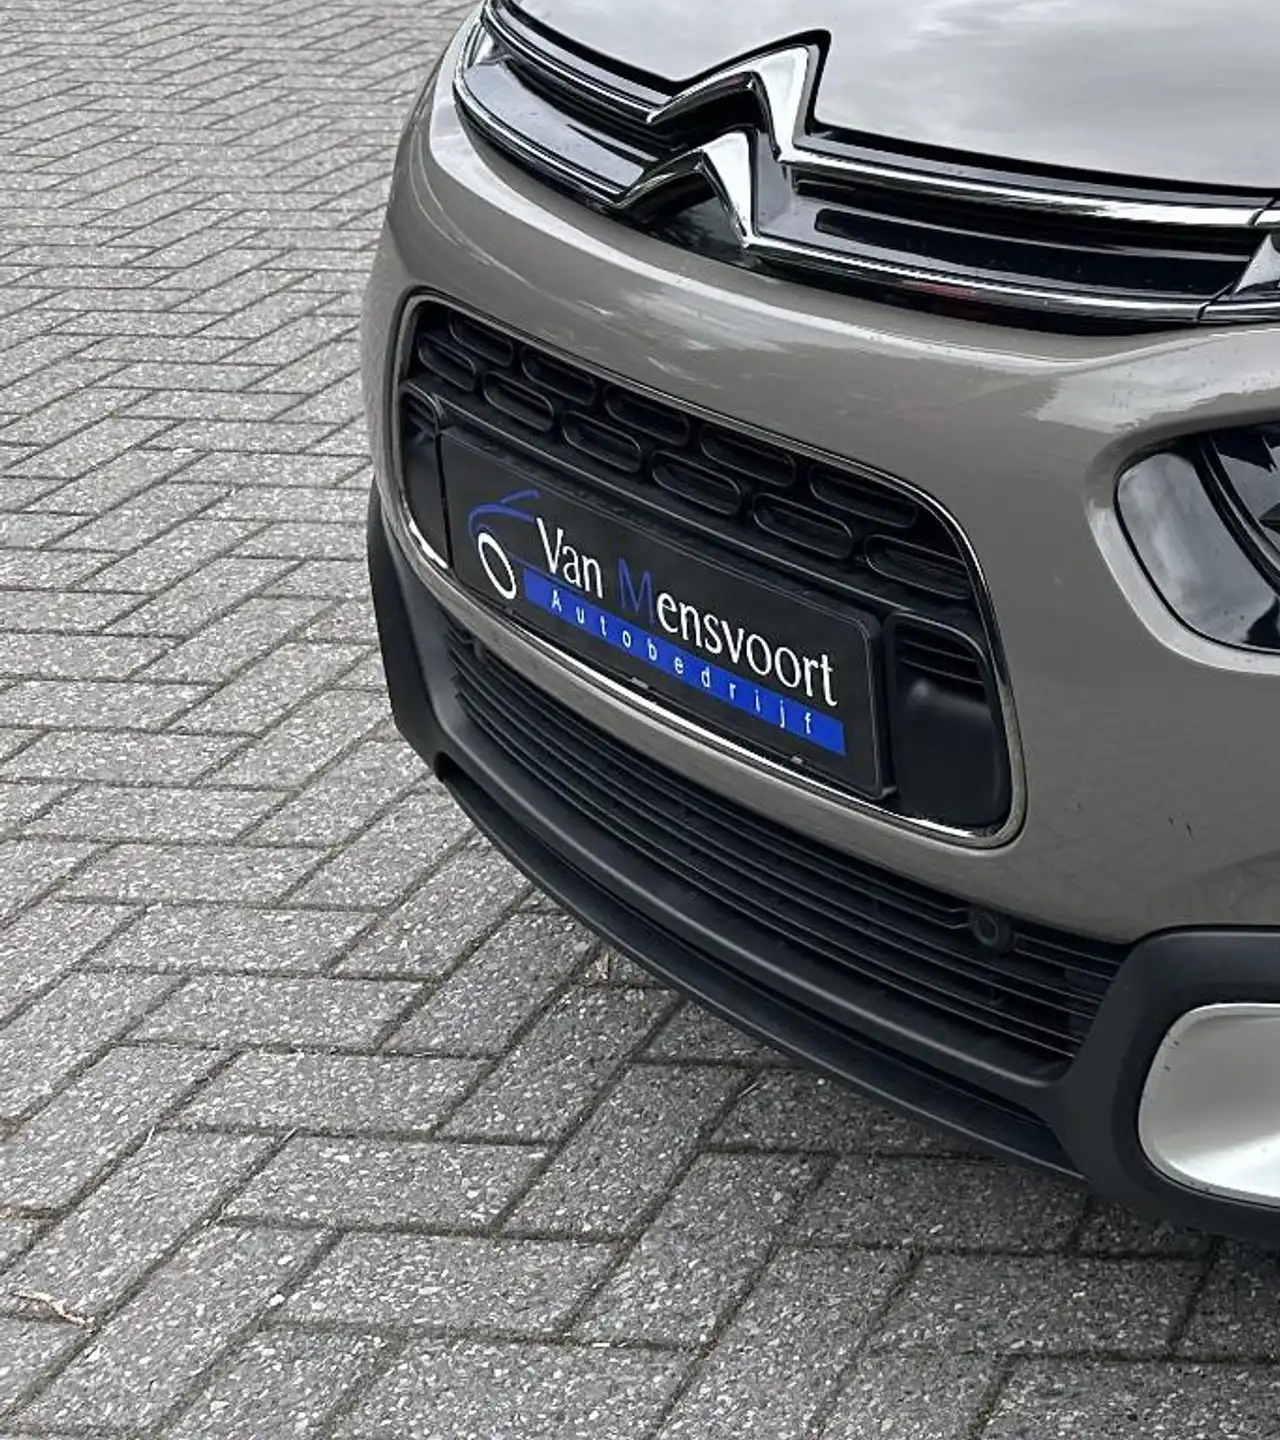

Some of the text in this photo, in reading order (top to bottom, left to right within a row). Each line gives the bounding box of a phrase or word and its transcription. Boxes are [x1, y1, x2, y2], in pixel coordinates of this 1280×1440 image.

[536, 516, 839, 709] Van Mensvoort
[550, 589, 813, 736] Autobedrijf
